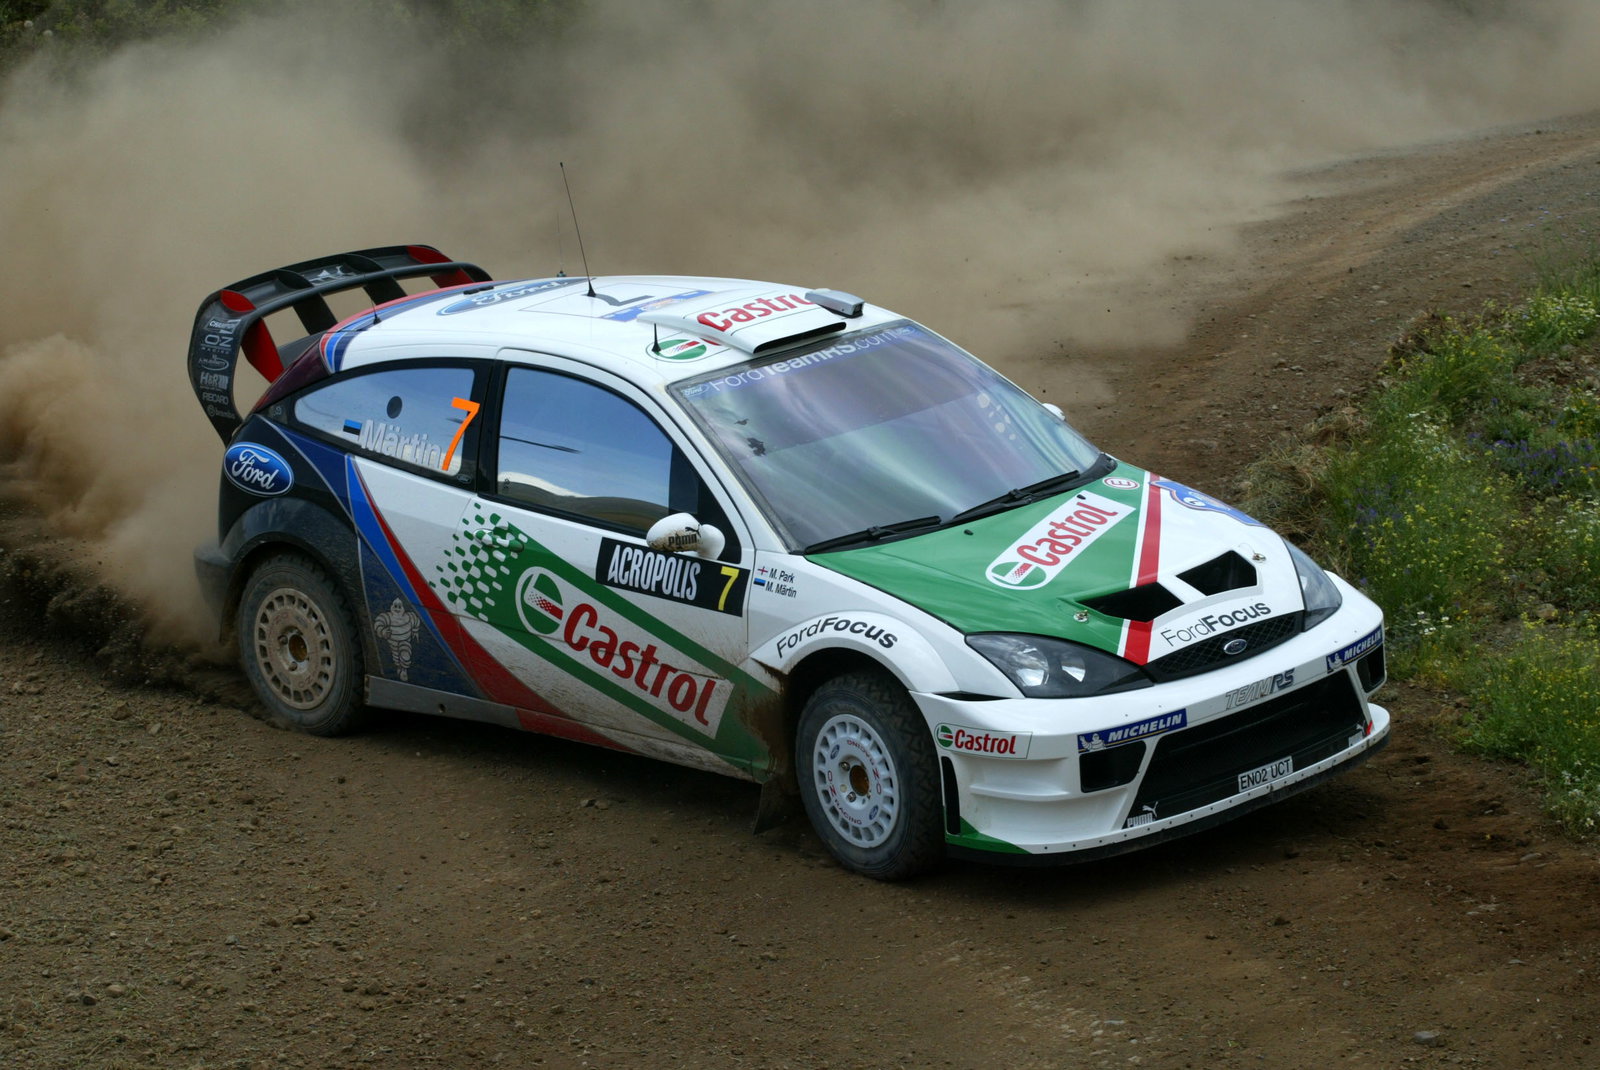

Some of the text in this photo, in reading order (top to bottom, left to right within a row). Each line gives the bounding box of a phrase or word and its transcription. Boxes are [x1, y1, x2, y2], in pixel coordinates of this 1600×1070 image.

[359, 419, 442, 469] Märtin
[442, 397, 480, 471] 7
[231, 449, 276, 491] Ford
[1016, 501, 1119, 567] Castrol
[607, 543, 740, 612] ACROPOLIS 7
[765, 581, 774, 593] M.
[769, 568, 795, 584] M. Park
[776, 615, 898, 659] FordFocus
[1160, 600, 1272, 648] FordFocus
[1343, 628, 1383, 661] MICHELIN
[563, 603, 717, 727] Castrol
[954, 729, 1017, 755] Castrol
[1107, 713, 1183, 744] MICHELIN
[1239, 758, 1292, 790] EN02 UCT
